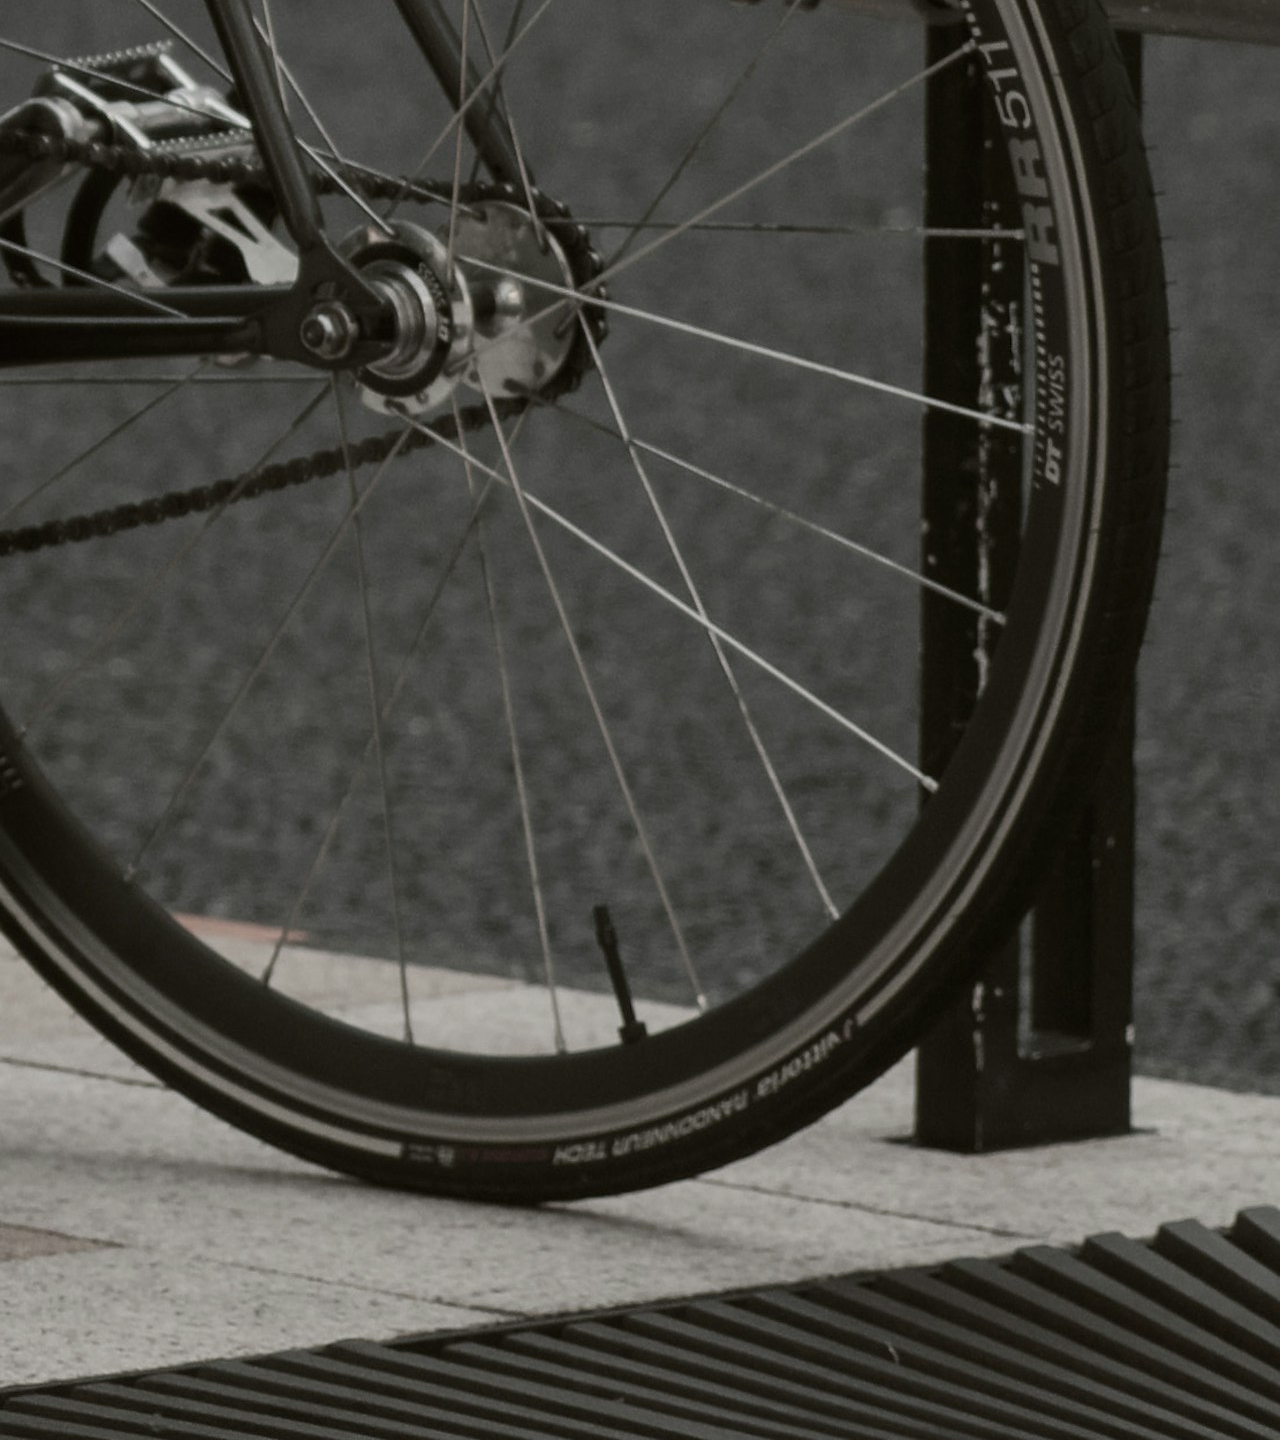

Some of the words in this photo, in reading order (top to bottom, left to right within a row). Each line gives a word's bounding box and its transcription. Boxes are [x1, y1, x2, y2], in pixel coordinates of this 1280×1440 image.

[1046, 354, 1065, 435] SWISS
[1045, 437, 1063, 486] DT
[552, 1140, 607, 1167] TECH
